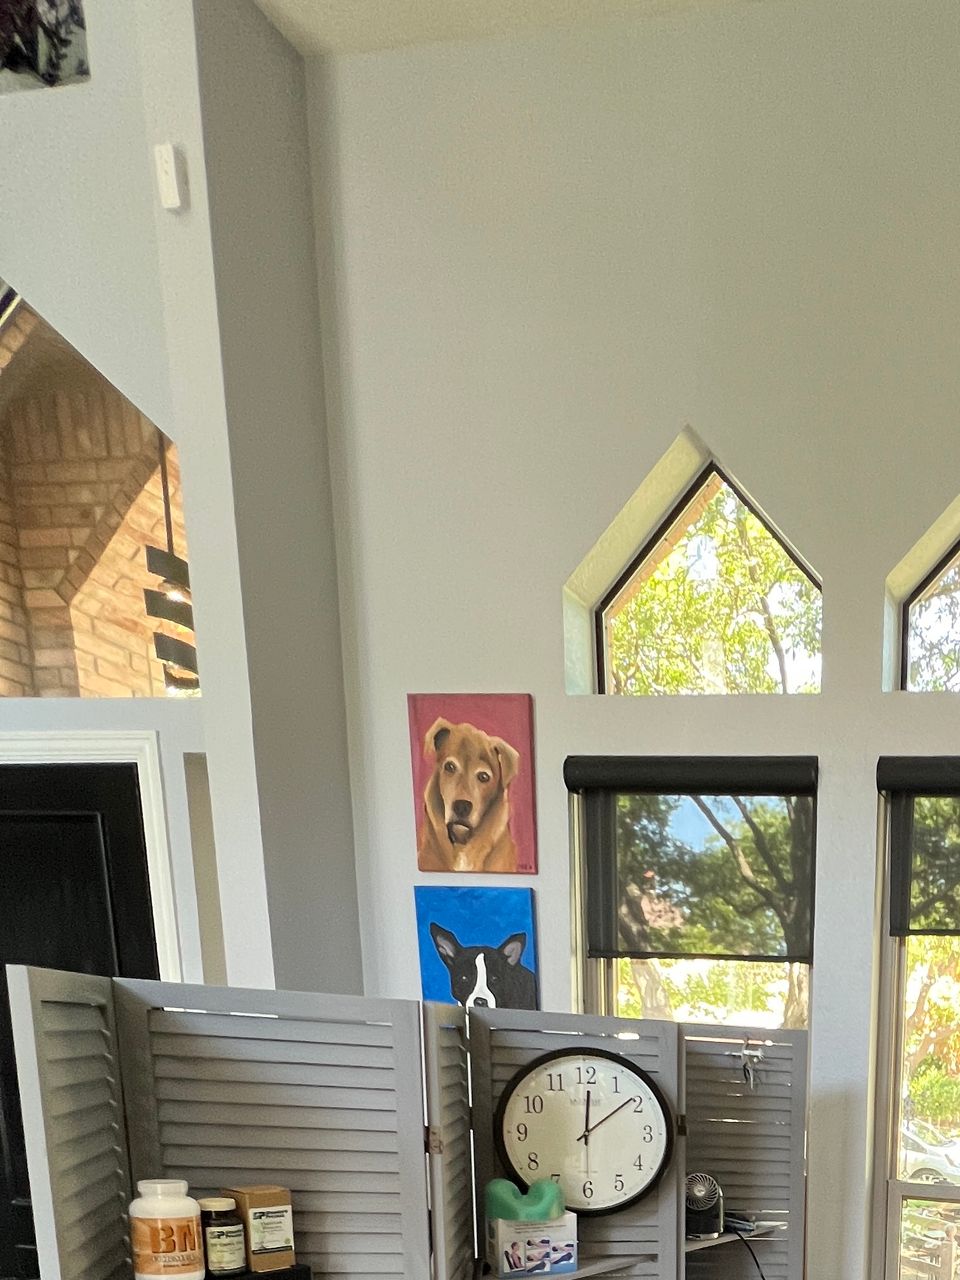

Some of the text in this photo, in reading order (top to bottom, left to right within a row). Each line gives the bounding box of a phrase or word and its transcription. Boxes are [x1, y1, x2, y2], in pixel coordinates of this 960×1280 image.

[547, 1073, 565, 1092] 11
[576, 1066, 597, 1085] 12
[612, 1076, 620, 1094] 1
[524, 1095, 544, 1114] 10
[632, 1095, 643, 1114] 2
[516, 1123, 528, 1142] 9
[643, 1125, 653, 1143] 3
[527, 1152, 539, 1171] 8
[633, 1154, 643, 1171] 4
[582, 1180, 594, 1199] 6
[614, 1174, 625, 1192] 5
